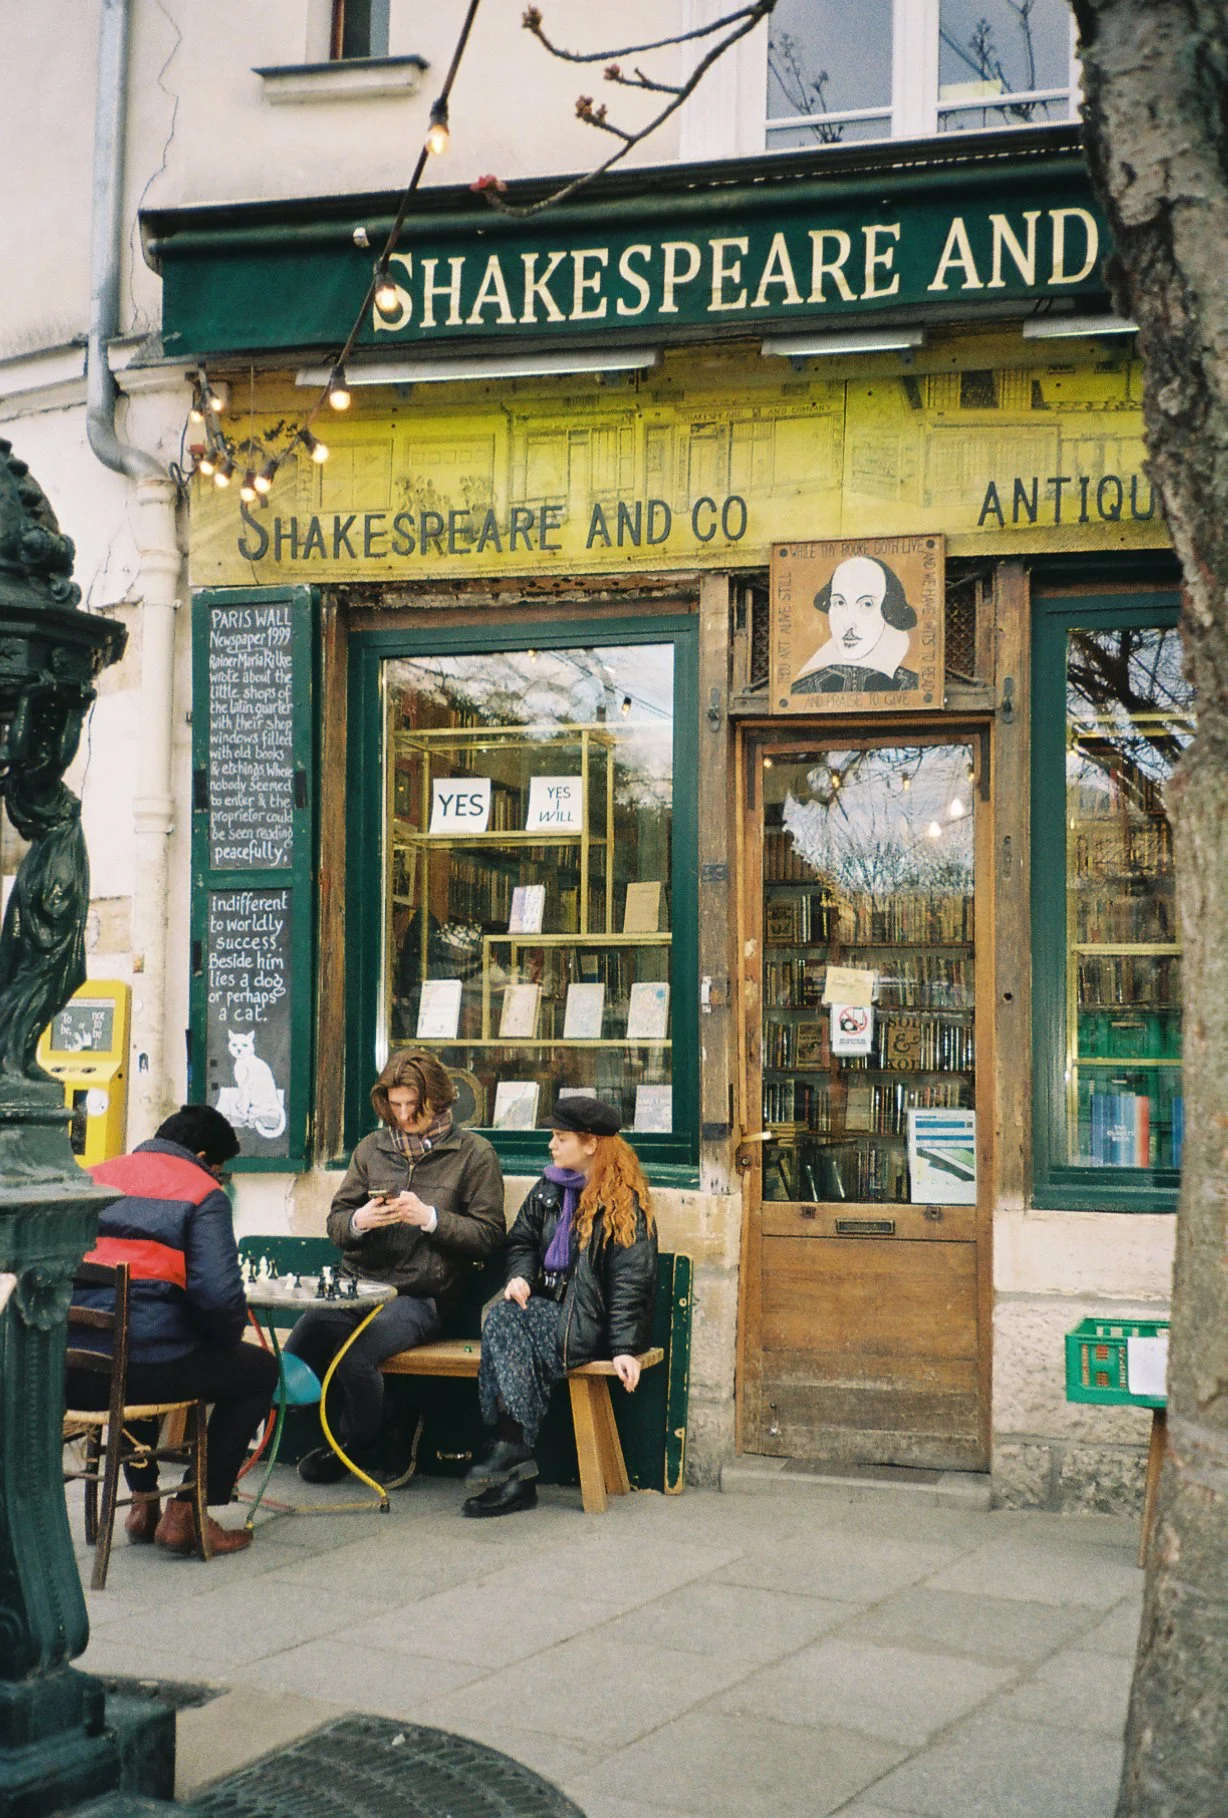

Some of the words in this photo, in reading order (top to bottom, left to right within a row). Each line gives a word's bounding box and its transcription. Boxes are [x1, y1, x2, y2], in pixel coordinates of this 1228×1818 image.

[372, 222, 901, 332] SHAKESPEARE
[927, 207, 1100, 293] AND
[238, 490, 564, 562] SHAKESPEARE
[586, 499, 672, 550] AND
[692, 495, 748, 543] CO
[900, 538, 924, 554] LIVE
[777, 572, 792, 601] STILL
[212, 609, 251, 629] PARIS
[255, 608, 292, 627] WALL
[210, 630, 266, 653] Newspaper
[267, 627, 291, 646] 1999
[238, 653, 263, 669] Maria
[263, 649, 292, 668] Rilke
[209, 669, 240, 683] wrote
[243, 669, 270, 683] about
[275, 668, 292, 683] the
[210, 684, 239, 699] little
[244, 685, 275, 703] shops
[278, 684, 292, 703] of
[868, 692, 880, 706] TO
[884, 691, 910, 706] GIVE
[210, 701, 228, 714] the
[255, 699, 293, 719] quarter
[210, 714, 232, 729] with
[235, 713, 263, 730] their
[265, 714, 292, 735] shop
[210, 730, 259, 744] windows
[262, 730, 292, 748] filled
[209, 744, 233, 760] with
[234, 744, 251, 759] old
[256, 745, 284, 760] books
[210, 761, 219, 776] &
[210, 775, 246, 792] nobody
[249, 779, 292, 793] seemed
[547, 786, 571, 799] YES
[210, 794, 222, 806] to
[224, 791, 254, 806] enter
[258, 792, 267, 808] &
[270, 793, 291, 808] the
[438, 794, 484, 817] YES
[210, 808, 265, 828] proprietor
[266, 807, 293, 823] could
[539, 811, 573, 822] WILL
[212, 825, 225, 840] be
[228, 828, 254, 840] seen
[256, 824, 293, 848] reading
[210, 915, 224, 933] to
[226, 913, 283, 937] worldly
[216, 936, 282, 951] success.
[208, 951, 254, 969] Beside
[257, 950, 284, 969] him
[210, 970, 236, 987] lies
[240, 973, 249, 987] a
[254, 970, 286, 997] dog
[208, 992, 222, 1002] or
[226, 987, 277, 1008] perhaps
[219, 1007, 227, 1021] a
[234, 1004, 267, 1022] cat.
